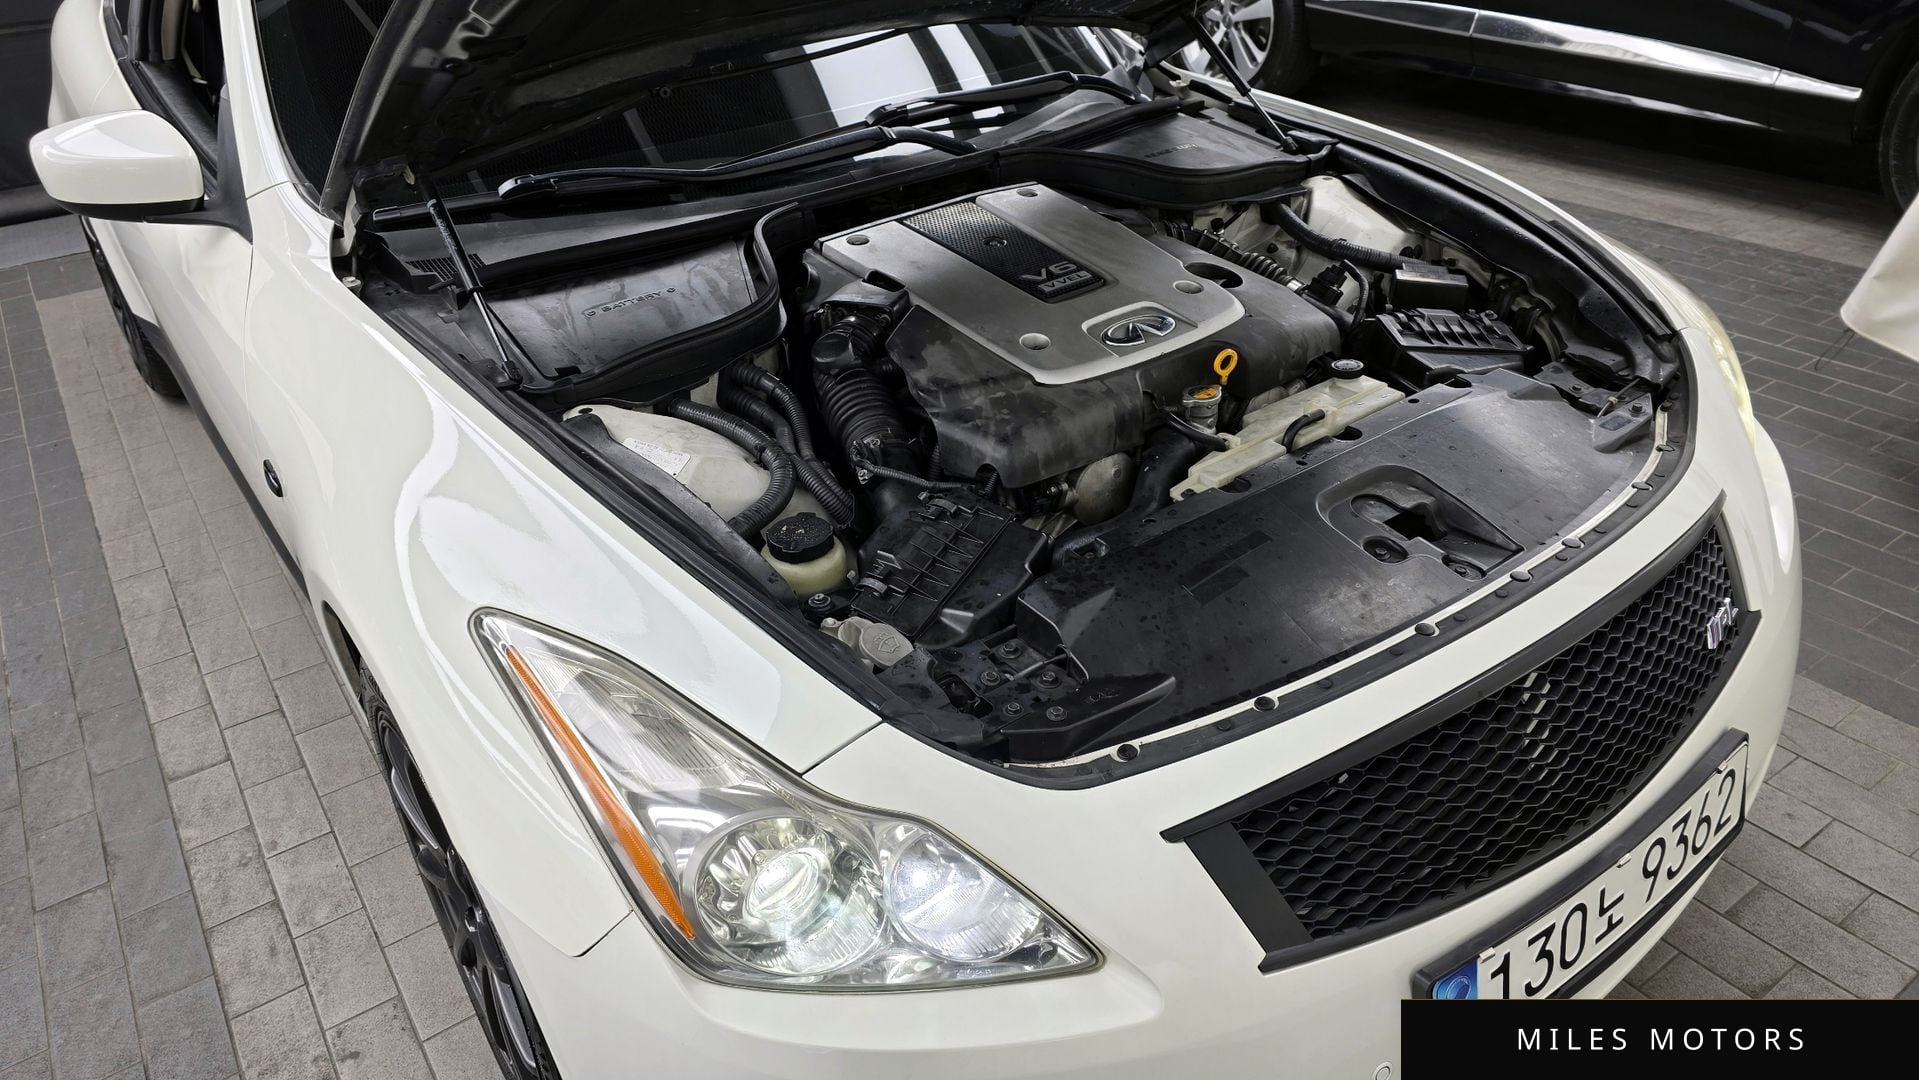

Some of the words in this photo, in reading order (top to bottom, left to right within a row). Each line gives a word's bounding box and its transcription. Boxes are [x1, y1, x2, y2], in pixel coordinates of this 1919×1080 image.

[1021, 261, 1077, 280] V6
[601, 290, 662, 313] BATTERY
[1490, 887, 1625, 999] 130노
[1642, 768, 1736, 904] 9362
